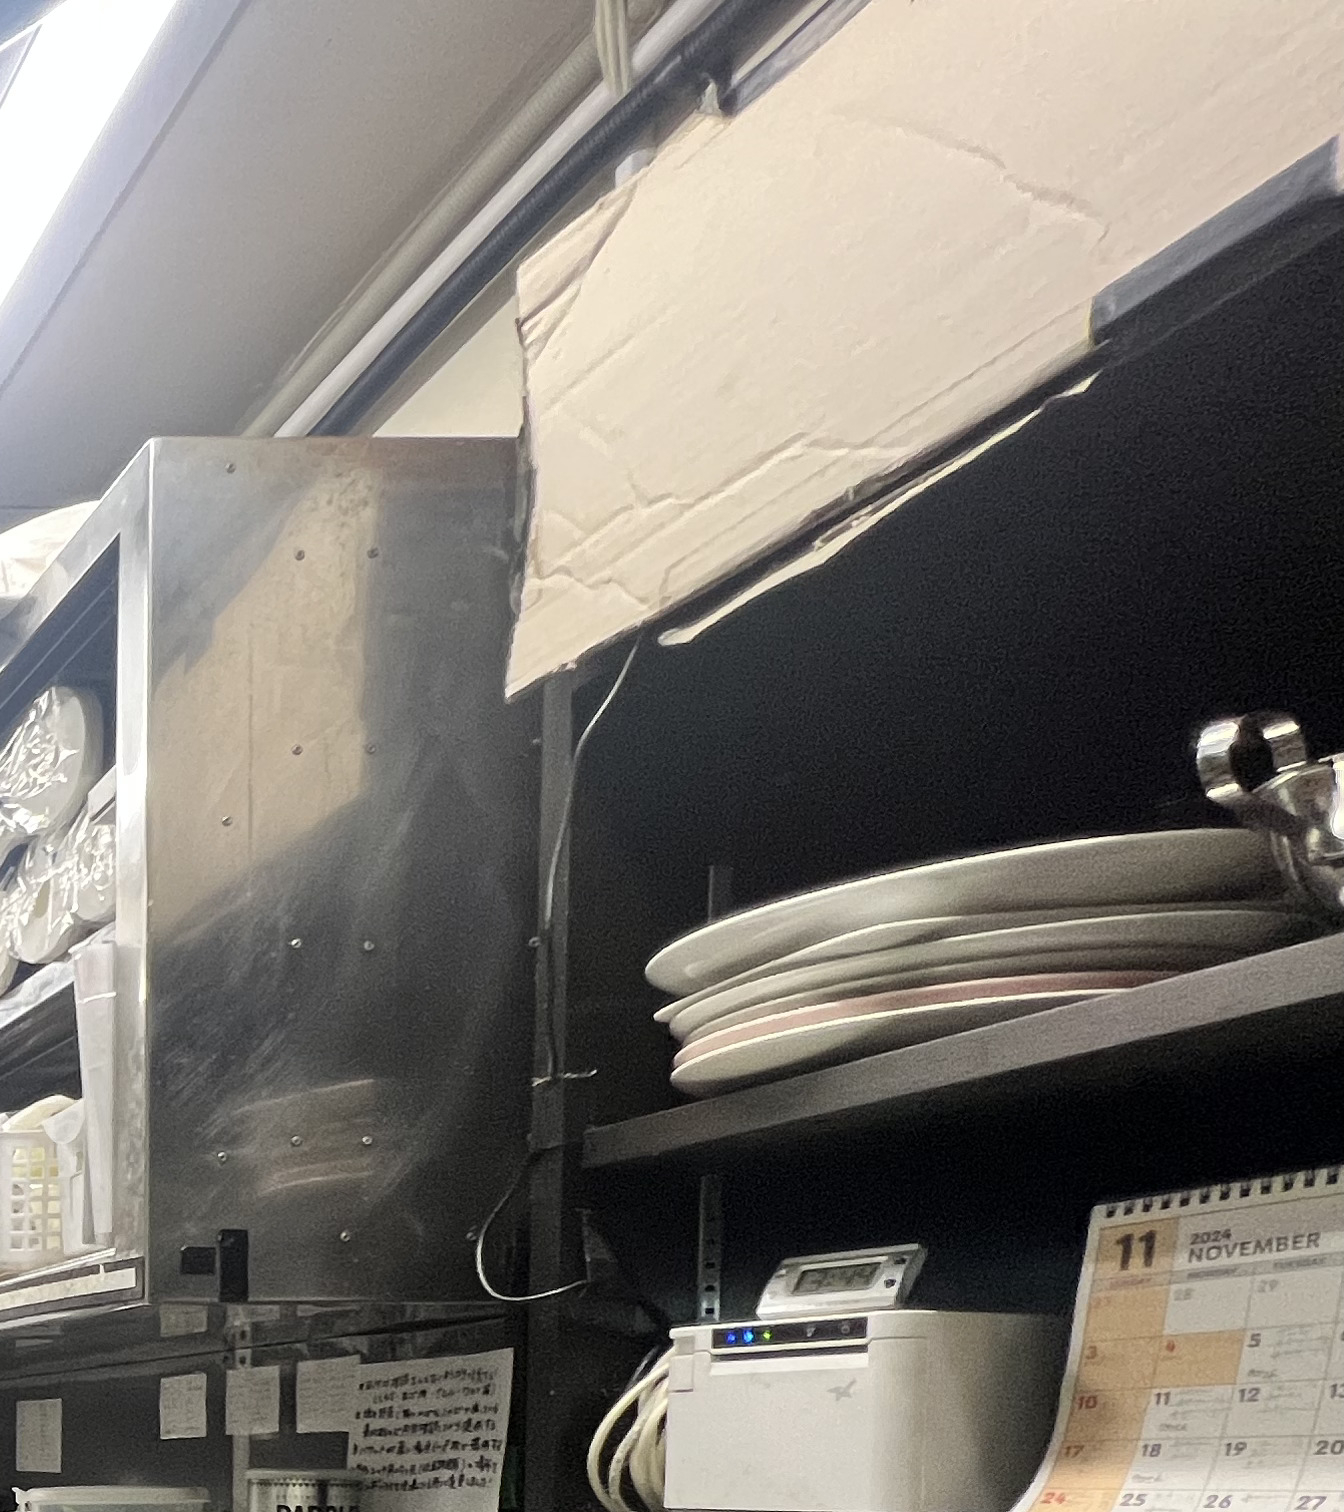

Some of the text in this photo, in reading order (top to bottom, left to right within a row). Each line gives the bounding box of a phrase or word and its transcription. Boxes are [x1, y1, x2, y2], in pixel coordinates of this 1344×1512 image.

[1189, 1229, 1232, 1245] 2024
[1115, 1229, 1322, 1271] 11 NOVEMBER
[1246, 1332, 1262, 1348] 5
[1075, 1395, 1098, 1410] 10
[1153, 1391, 1172, 1406] 11
[1237, 1387, 1261, 1403] 12
[1062, 1440, 1344, 1458] 17 18 19 20
[1040, 1492, 1328, 1511] 24 25 26 27
